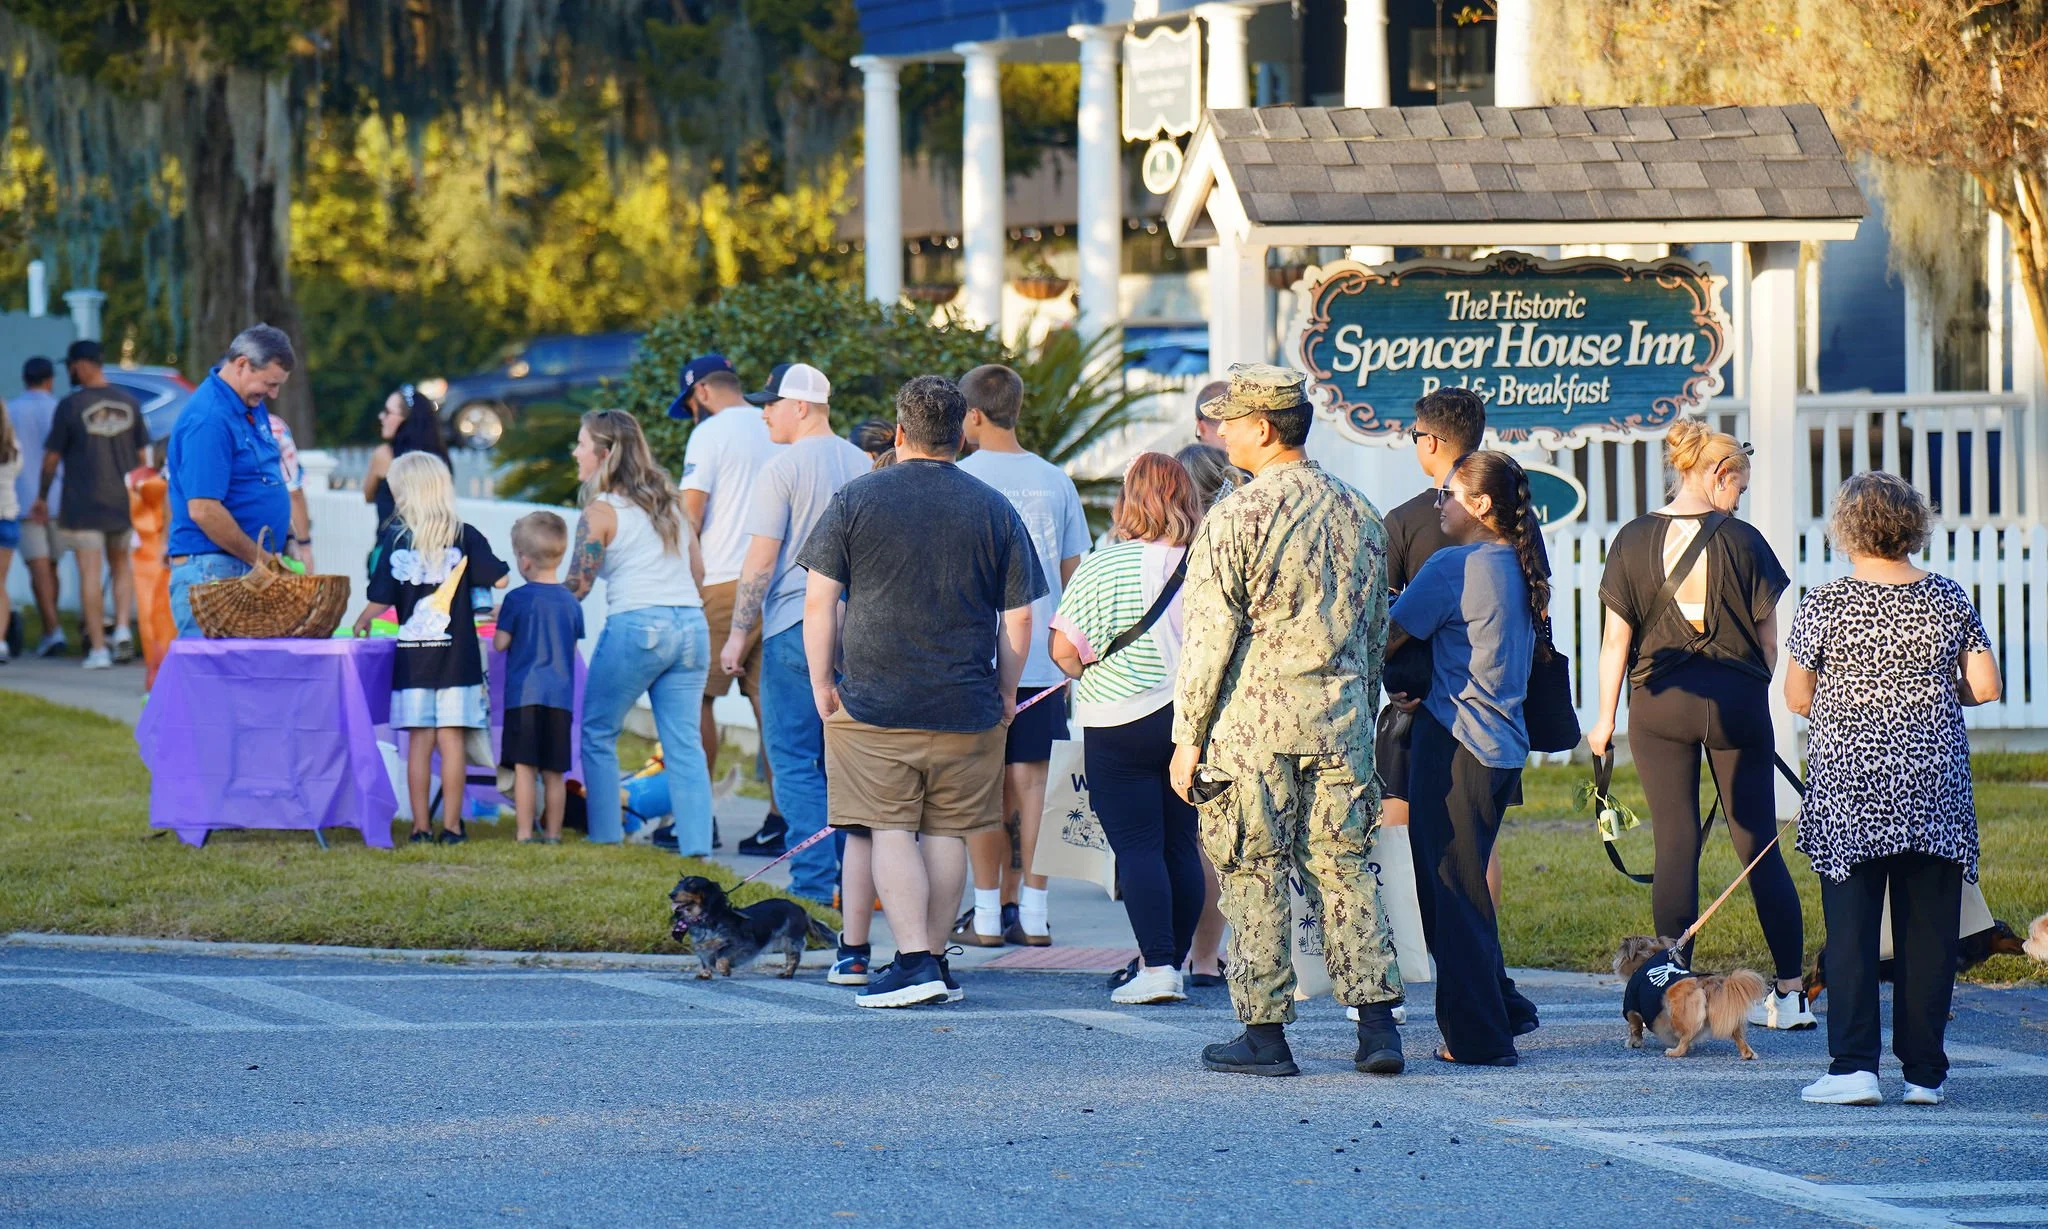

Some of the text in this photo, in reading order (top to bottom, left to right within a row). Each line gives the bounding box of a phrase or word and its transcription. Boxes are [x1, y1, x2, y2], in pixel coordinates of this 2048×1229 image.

[1445, 290, 1586, 321] The Historic
[1332, 320, 1696, 387] Spencer House Inn
[1422, 375, 1468, 397] Bd
[1497, 373, 1611, 415] Breakfast
